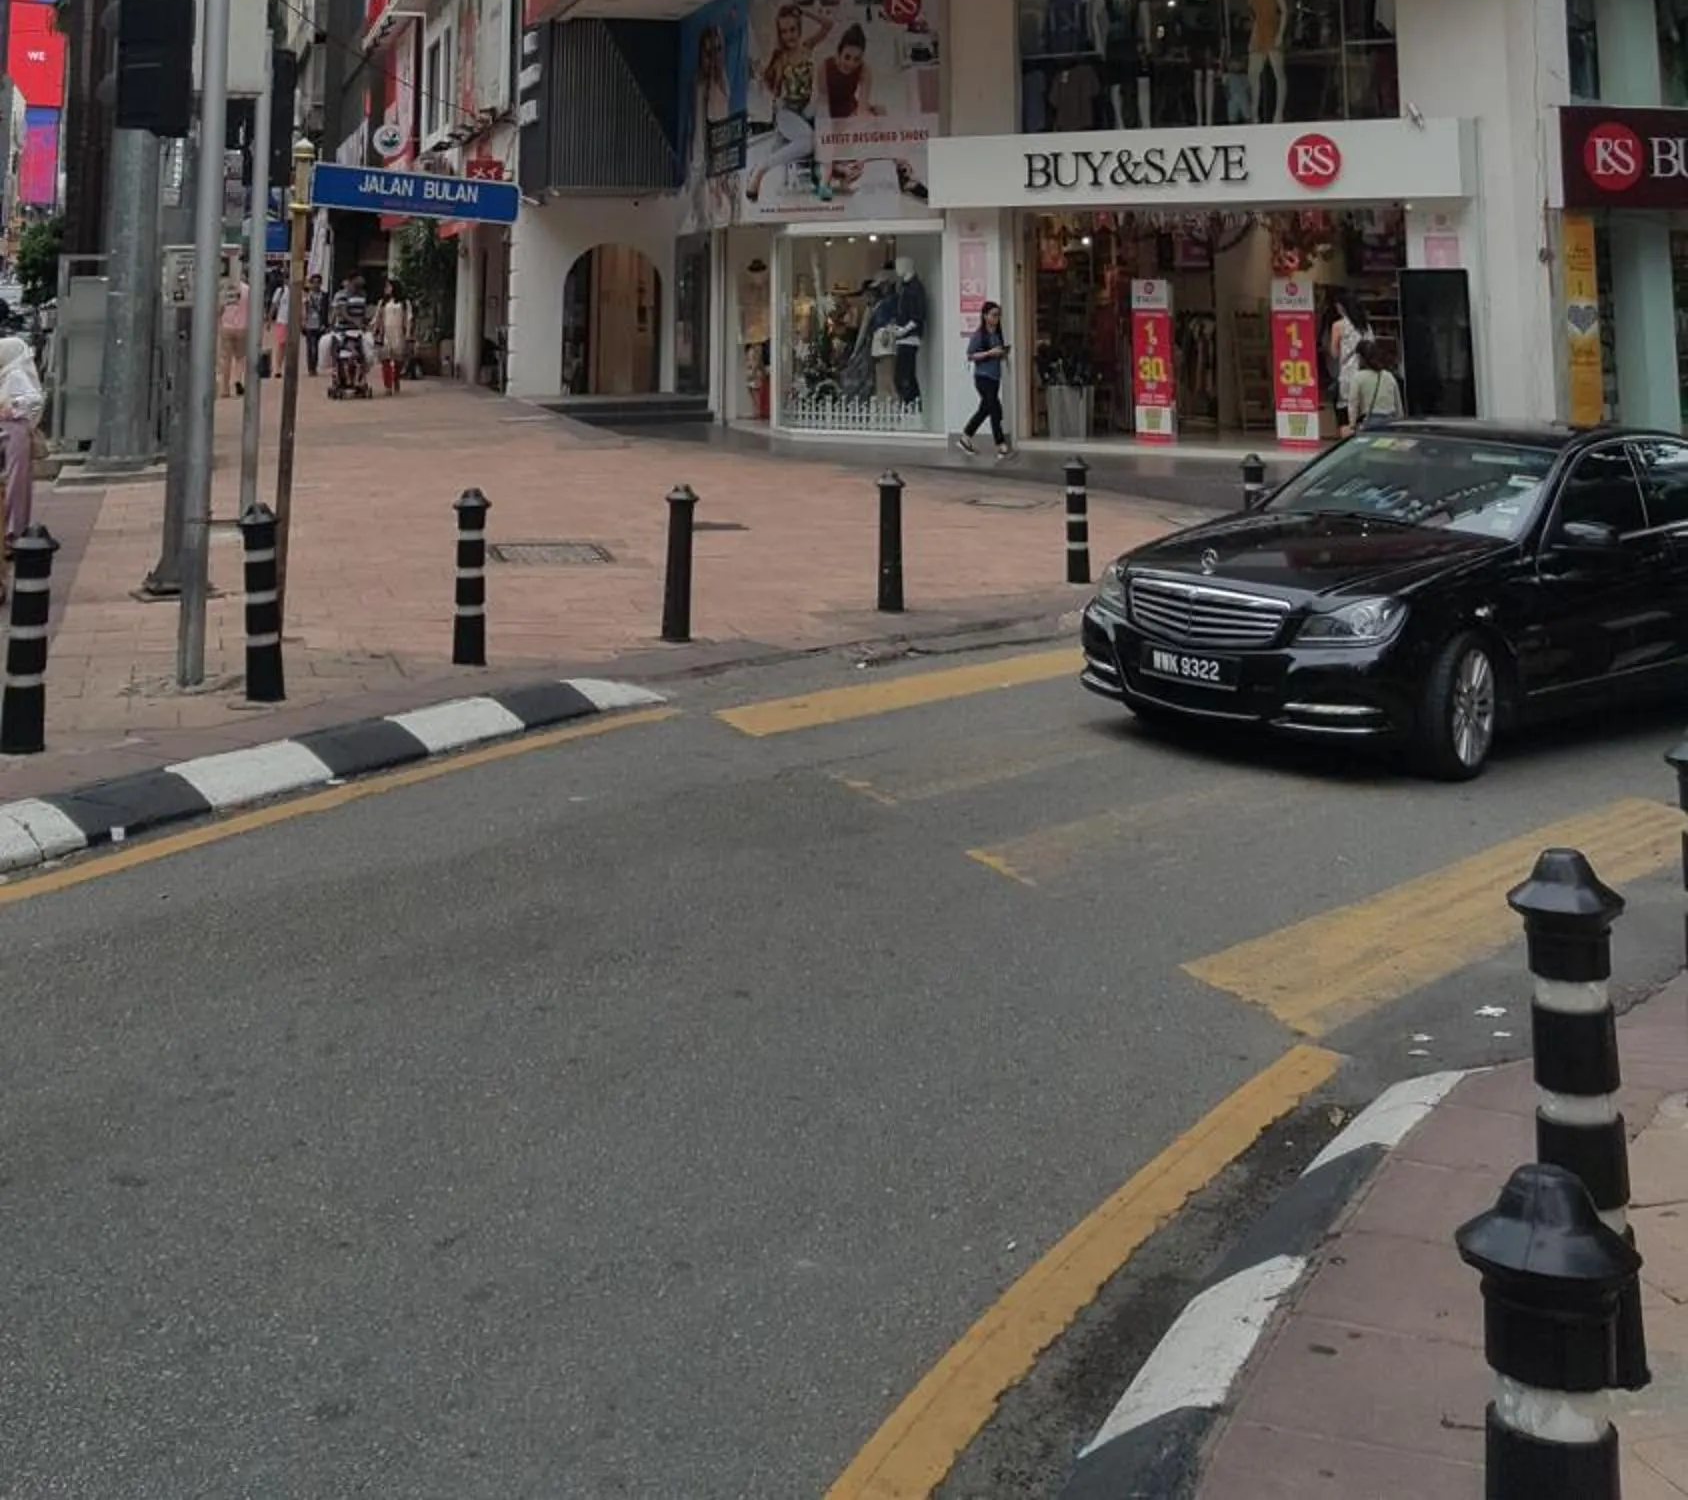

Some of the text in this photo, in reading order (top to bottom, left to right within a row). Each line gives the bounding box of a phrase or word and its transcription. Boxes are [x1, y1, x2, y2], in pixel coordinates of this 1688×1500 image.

[28, 51, 45, 61] WE
[1024, 144, 1249, 189] BUY&SAVE
[359, 175, 479, 203] JALAN BULAN
[1181, 658, 1220, 681] 9322
